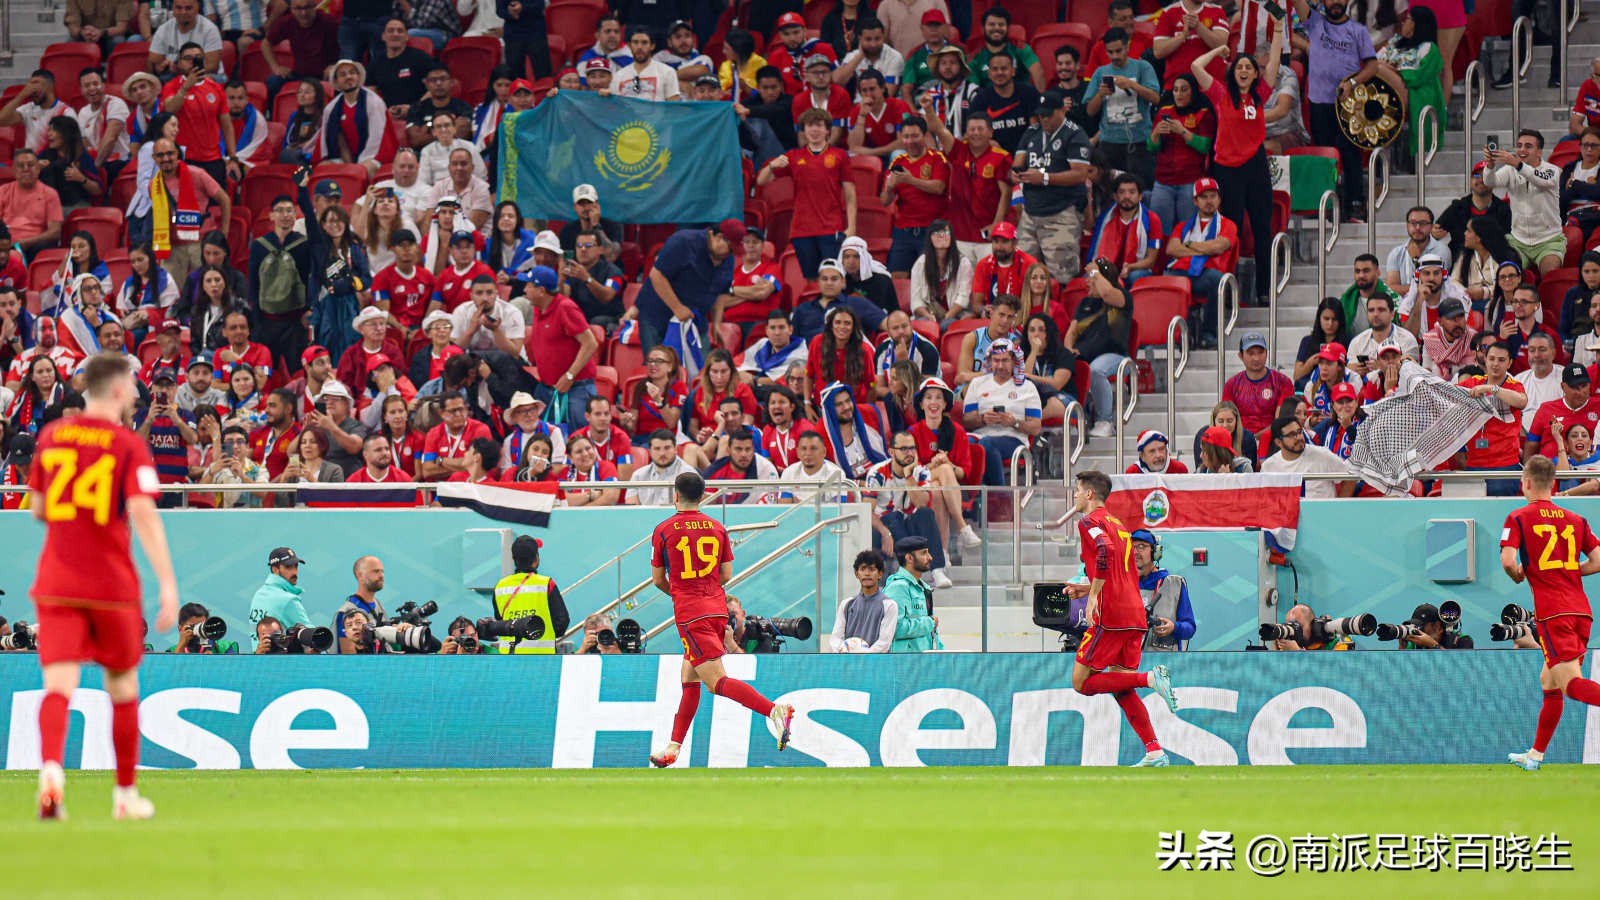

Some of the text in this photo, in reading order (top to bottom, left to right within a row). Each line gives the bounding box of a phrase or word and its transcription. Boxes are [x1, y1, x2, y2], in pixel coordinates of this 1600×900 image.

[1244, 105, 1257, 120] 19
[1029, 152, 1052, 168] Bell
[178, 214, 198, 224] CSR
[40, 447, 116, 527] 24
[1539, 508, 1565, 519] OLMO
[673, 520, 714, 530] C. SOLER
[1117, 529, 1133, 573] 7
[1532, 524, 1579, 571] 21
[675, 535, 720, 580] 19
[1078, 631, 1093, 650] 7
[552, 654, 1367, 768] Hisense
